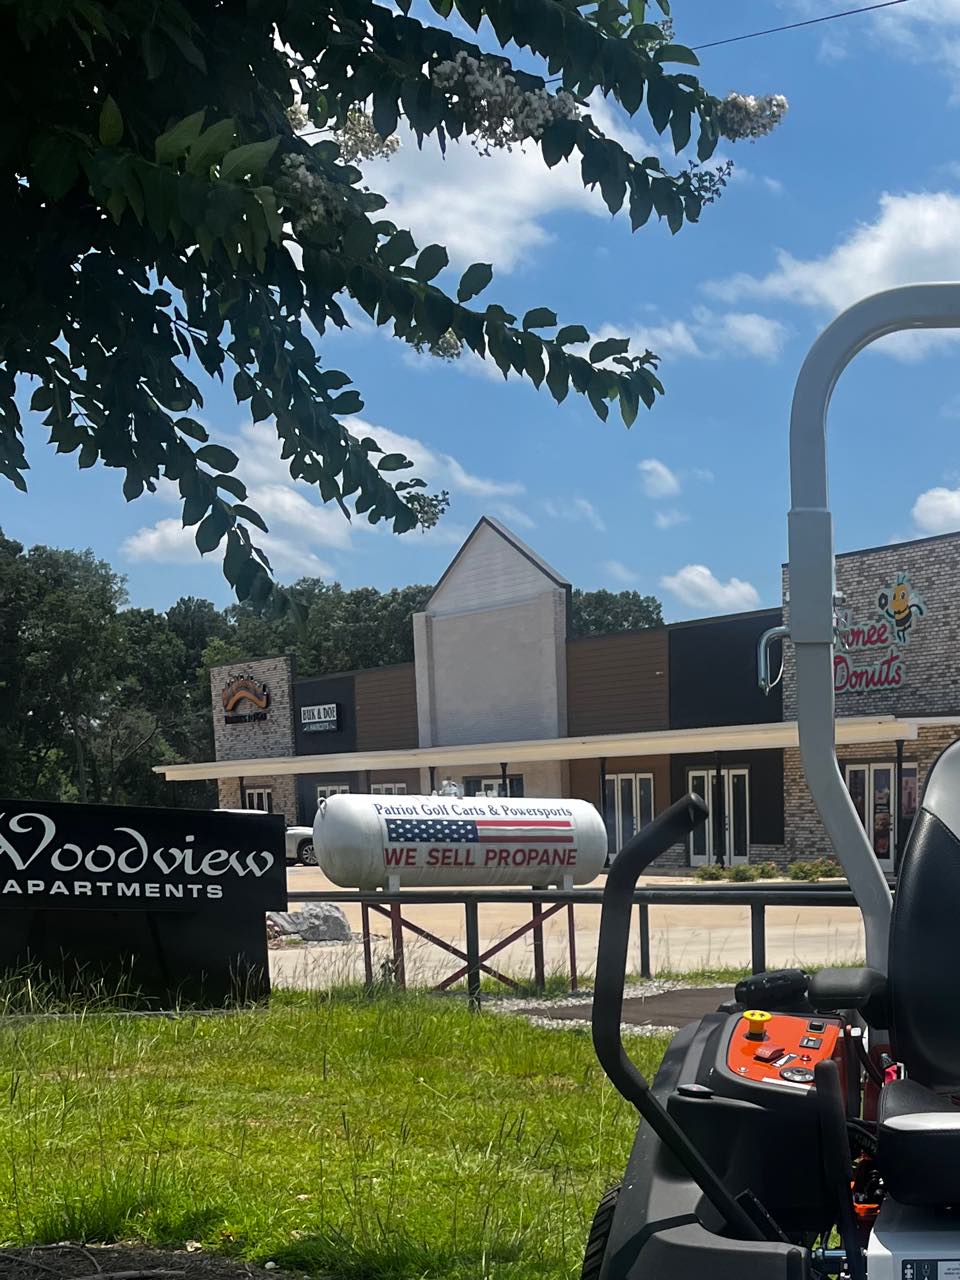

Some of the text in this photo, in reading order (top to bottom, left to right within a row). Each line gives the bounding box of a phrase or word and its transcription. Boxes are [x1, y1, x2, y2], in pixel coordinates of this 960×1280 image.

[834, 649, 902, 692] Donuts
[323, 706, 336, 719] DOE
[374, 803, 573, 819] Patriot Golf Carts & Powersports
[0, 812, 274, 877] Woodview
[384, 848, 577, 866] WE SELL PROPANE
[2, 879, 223, 898] APARTMENTS
